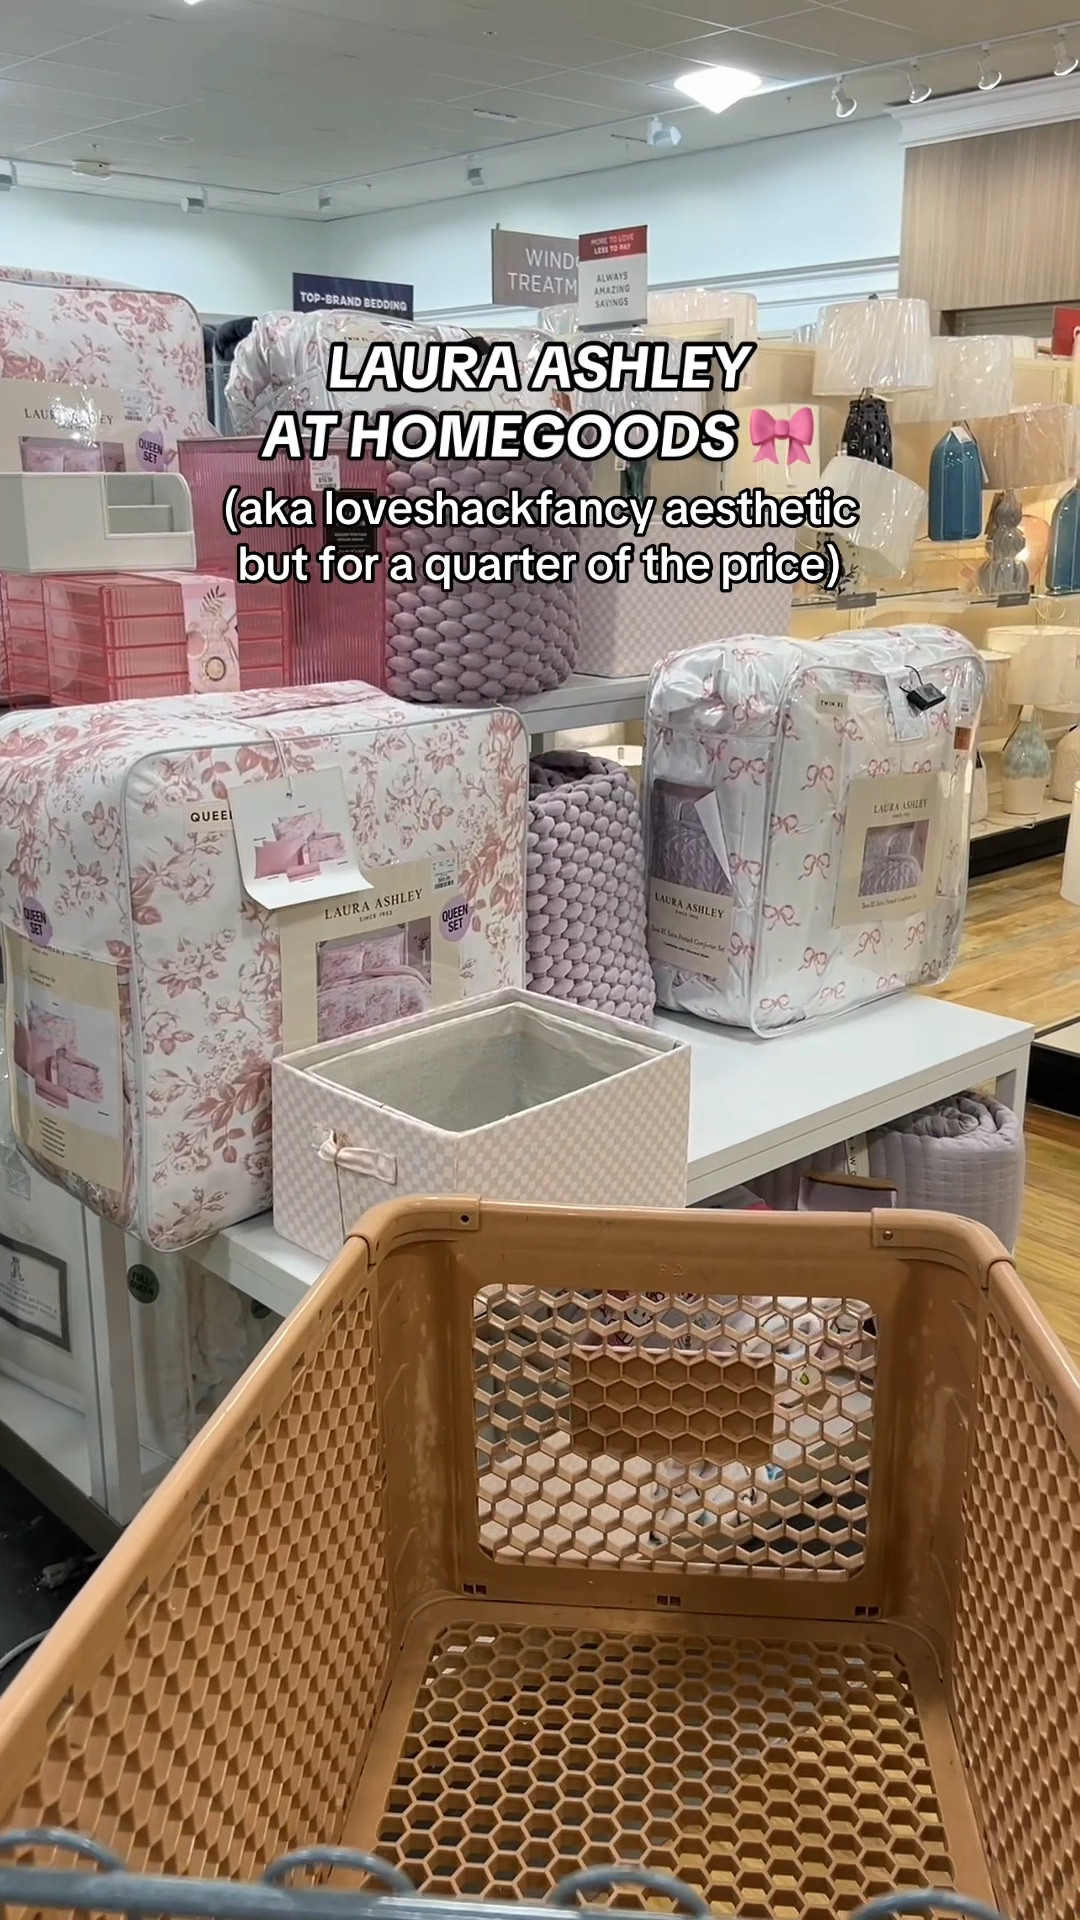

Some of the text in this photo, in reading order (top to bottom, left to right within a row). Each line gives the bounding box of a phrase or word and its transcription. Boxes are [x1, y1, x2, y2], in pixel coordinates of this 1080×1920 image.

[609, 235, 617, 243] TO
[618, 233, 634, 242] LOVE
[594, 246, 609, 255] LESS
[619, 243, 632, 251] PAY
[596, 271, 629, 283] ALWAYS
[594, 284, 631, 296] AMAZING
[300, 291, 408, 311] TOP-BRAND BEDDING
[595, 297, 629, 309] SAVINGS
[139, 438, 163, 455] QUEEN
[143, 451, 157, 464] SET
[873, 799, 928, 814] LAURA ASHLEY
[190, 810, 233, 822] QUEE
[324, 888, 423, 920] LAURA ASHLEY
[654, 891, 683, 909] LAURA
[685, 902, 725, 919] ASHLEY
[23, 906, 47, 925] QUEEN
[359, 913, 377, 923] SINCE
[441, 903, 469, 922] QUEEN
[29, 921, 43, 936] SET
[448, 917, 463, 932] SET
